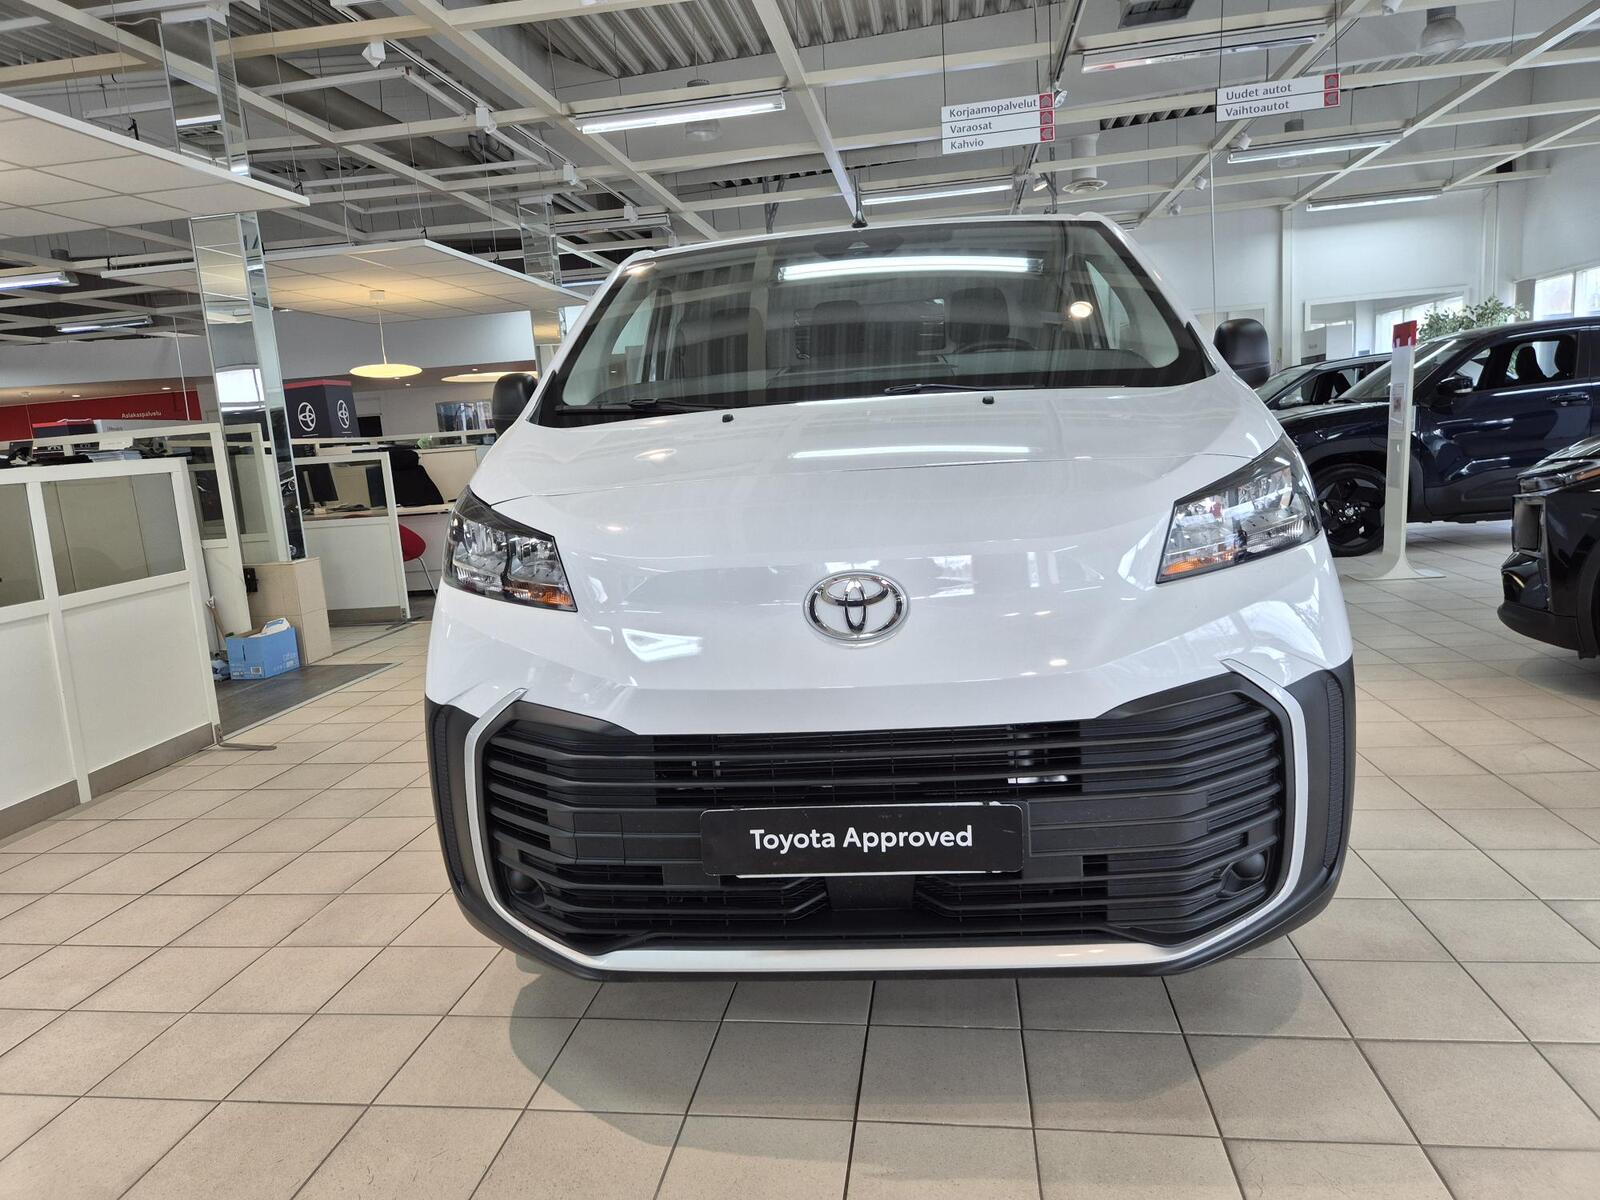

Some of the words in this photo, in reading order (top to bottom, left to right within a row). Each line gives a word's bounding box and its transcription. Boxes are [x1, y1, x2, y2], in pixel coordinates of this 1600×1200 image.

[1226, 89, 1259, 101] Uudet
[1262, 84, 1292, 96] autot
[949, 99, 1038, 118] Korjaamopalvelut
[1225, 101, 1290, 117] Vaihtoautot
[950, 121, 993, 134] Varaosat
[950, 139, 984, 150] Kahvio
[749, 829, 836, 854] Toyota
[843, 825, 973, 853] Approved
